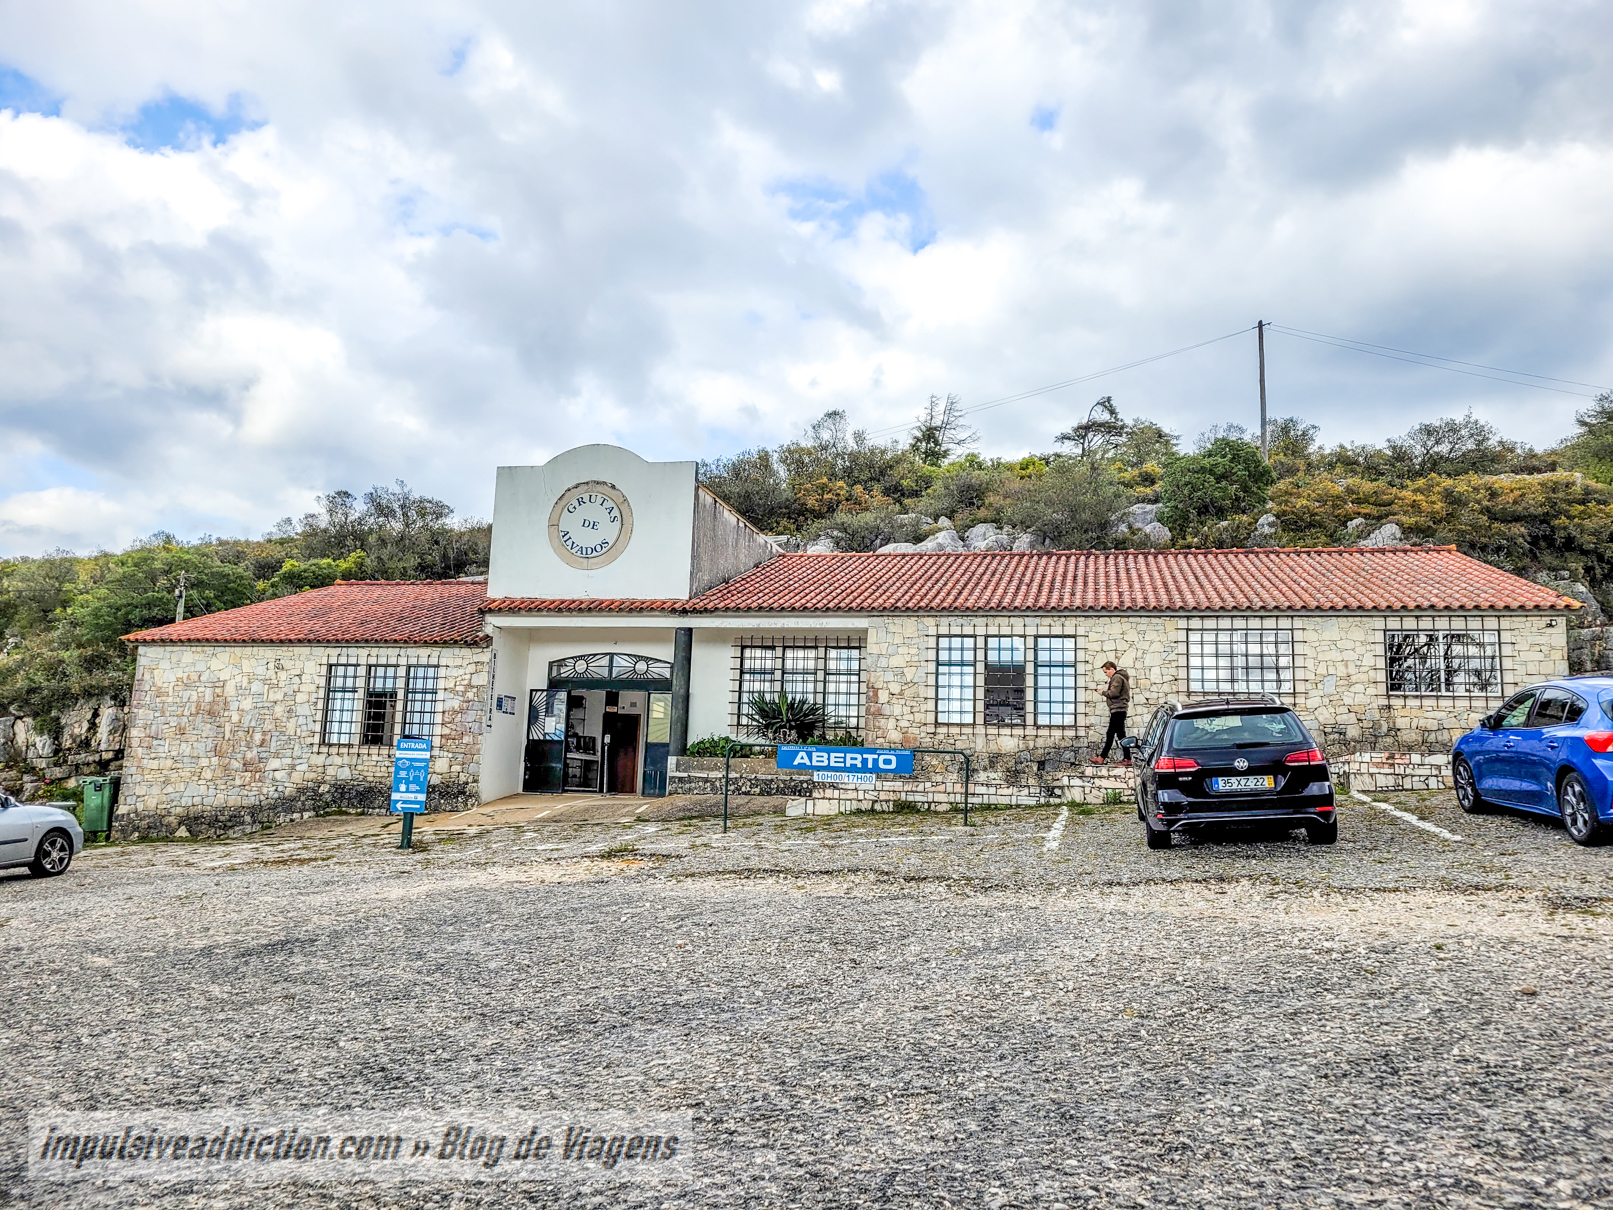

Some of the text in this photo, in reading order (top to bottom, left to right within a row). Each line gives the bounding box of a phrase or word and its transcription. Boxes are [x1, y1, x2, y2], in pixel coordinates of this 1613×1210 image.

[567, 494, 618, 523] GRUTAS
[581, 518, 599, 530] DE
[560, 529, 609, 555] ALVADOS
[488, 653, 497, 721] BILHETEIRA
[793, 752, 897, 769] ABERTO
[816, 773, 873, 783] 10H00/17H00
